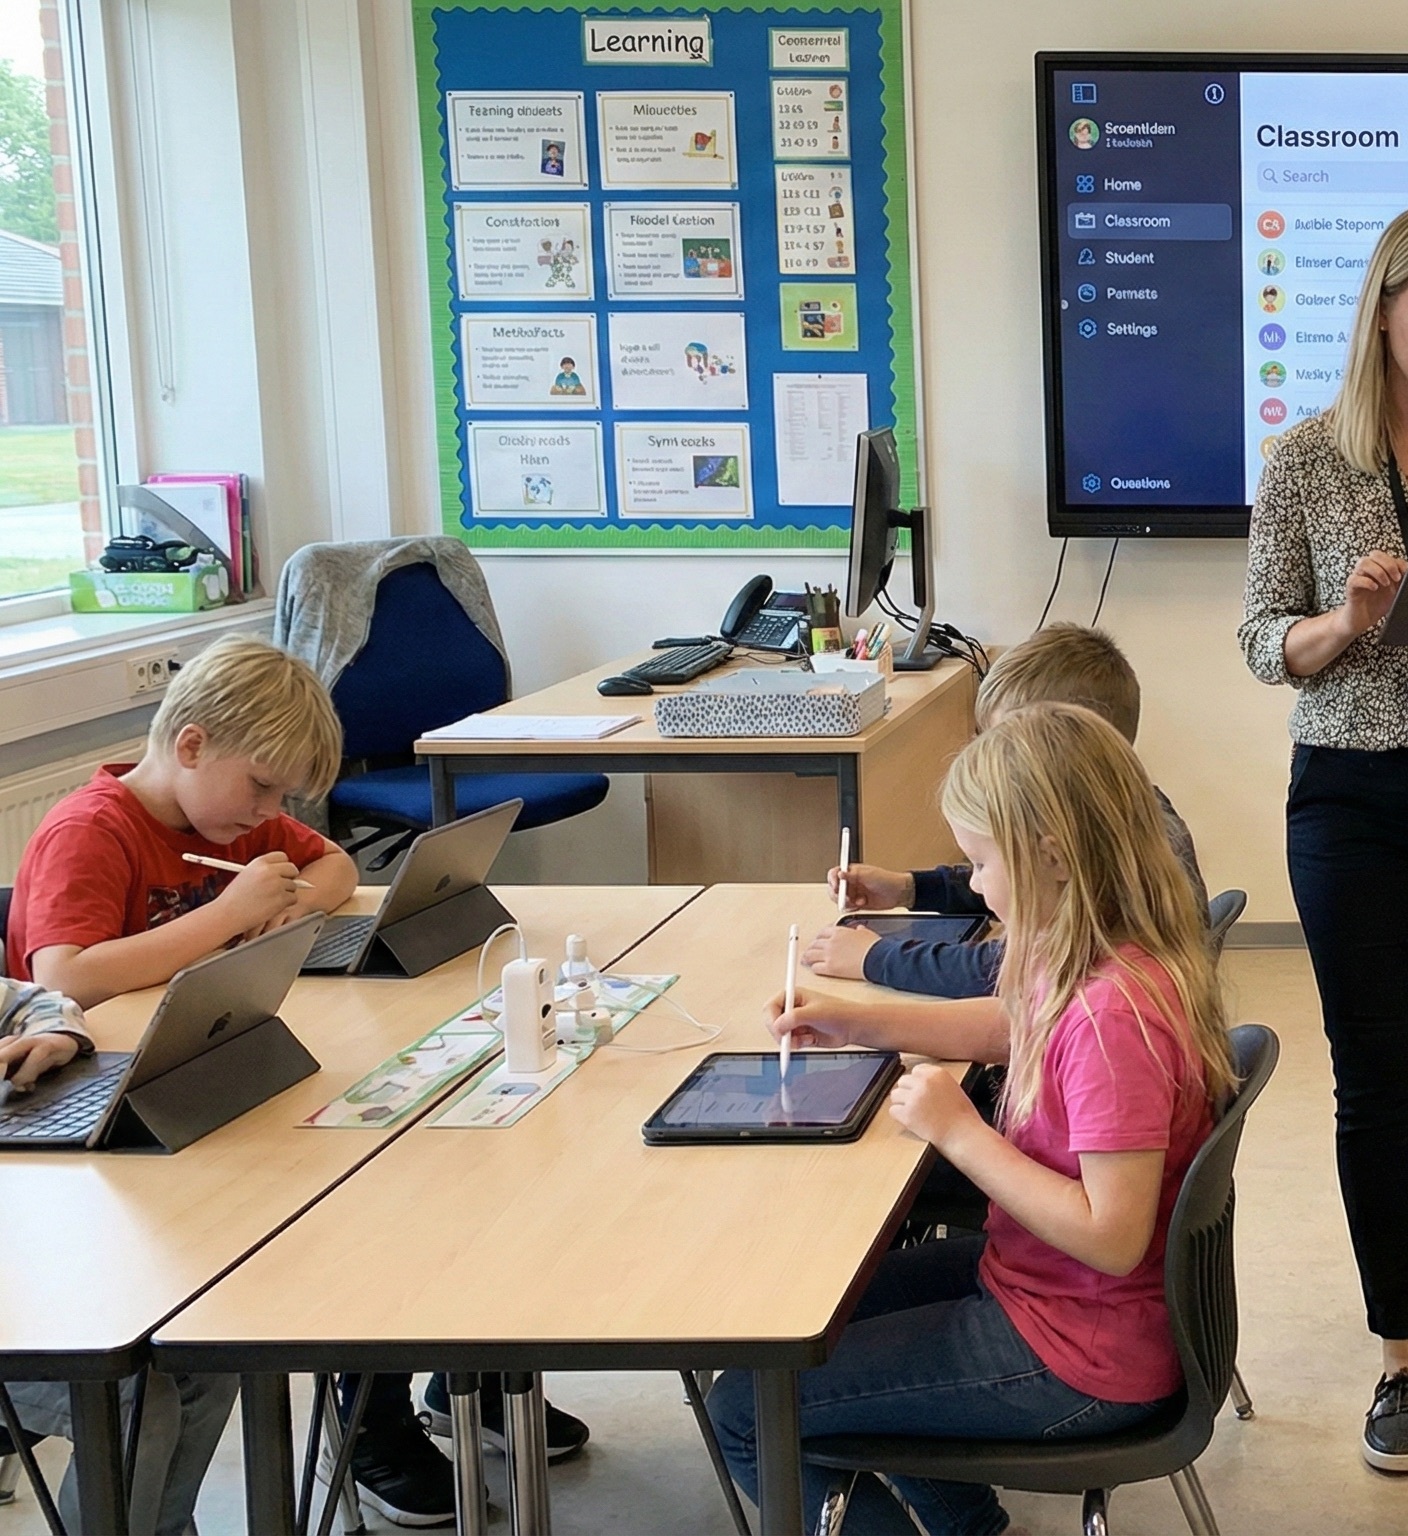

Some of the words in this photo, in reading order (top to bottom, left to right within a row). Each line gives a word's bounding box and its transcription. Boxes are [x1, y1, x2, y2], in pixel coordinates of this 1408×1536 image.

[1257, 125, 1399, 147] Classroom
[1283, 170, 1329, 183] Search
[1104, 178, 1142, 191] Home
[1104, 214, 1171, 228] Classroom
[1105, 251, 1155, 264] Student
[1107, 322, 1158, 338] Settings
